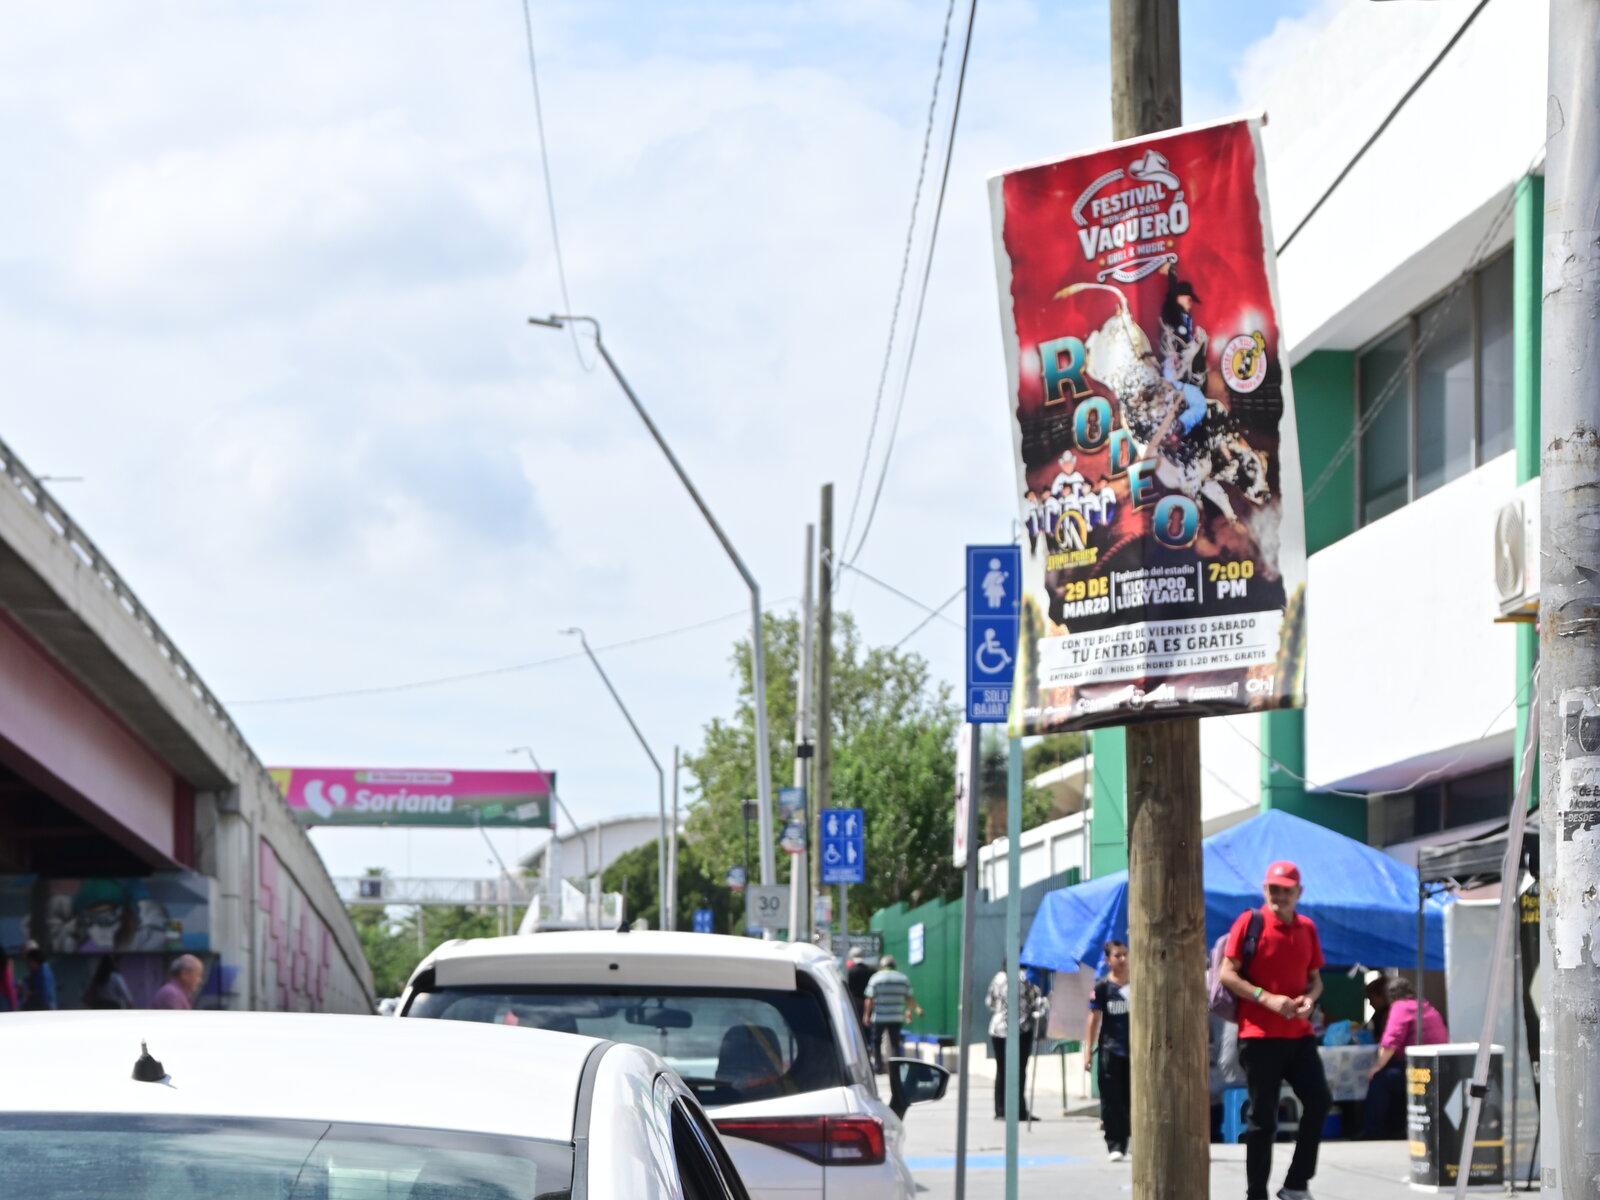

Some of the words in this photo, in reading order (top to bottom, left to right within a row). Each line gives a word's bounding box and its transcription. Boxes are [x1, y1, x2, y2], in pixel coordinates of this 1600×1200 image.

[1091, 183, 1166, 218] FESTIVAL
[1078, 200, 1189, 261] VAQUERO
[1150, 565, 1163, 577] del
[1165, 564, 1195, 576] estadio
[1208, 560, 1254, 582] 7:00
[1064, 581, 1087, 602] 29
[1088, 576, 1109, 597] DE
[1121, 576, 1187, 595] KICKAPOO
[1217, 579, 1248, 599] PM
[1062, 596, 1110, 619] MARZO
[1116, 590, 1152, 609] LUCKY
[1152, 588, 1195, 605] EAGLE
[1062, 639, 1081, 650] CON
[1084, 635, 1096, 647] TU
[1148, 623, 1197, 638] VIERNES
[1200, 622, 1208, 633] O
[1072, 648, 1090, 663] TU
[1094, 639, 1157, 660] ENTRADA
[1164, 637, 1181, 653] ES
[1187, 632, 1244, 650] GRATIS
[1235, 649, 1267, 661] GRATIS
[984, 689, 1009, 702] SOLO
[1245, 675, 1275, 697] Oh!
[354, 788, 454, 813] Soriana
[759, 896, 780, 911] 30
